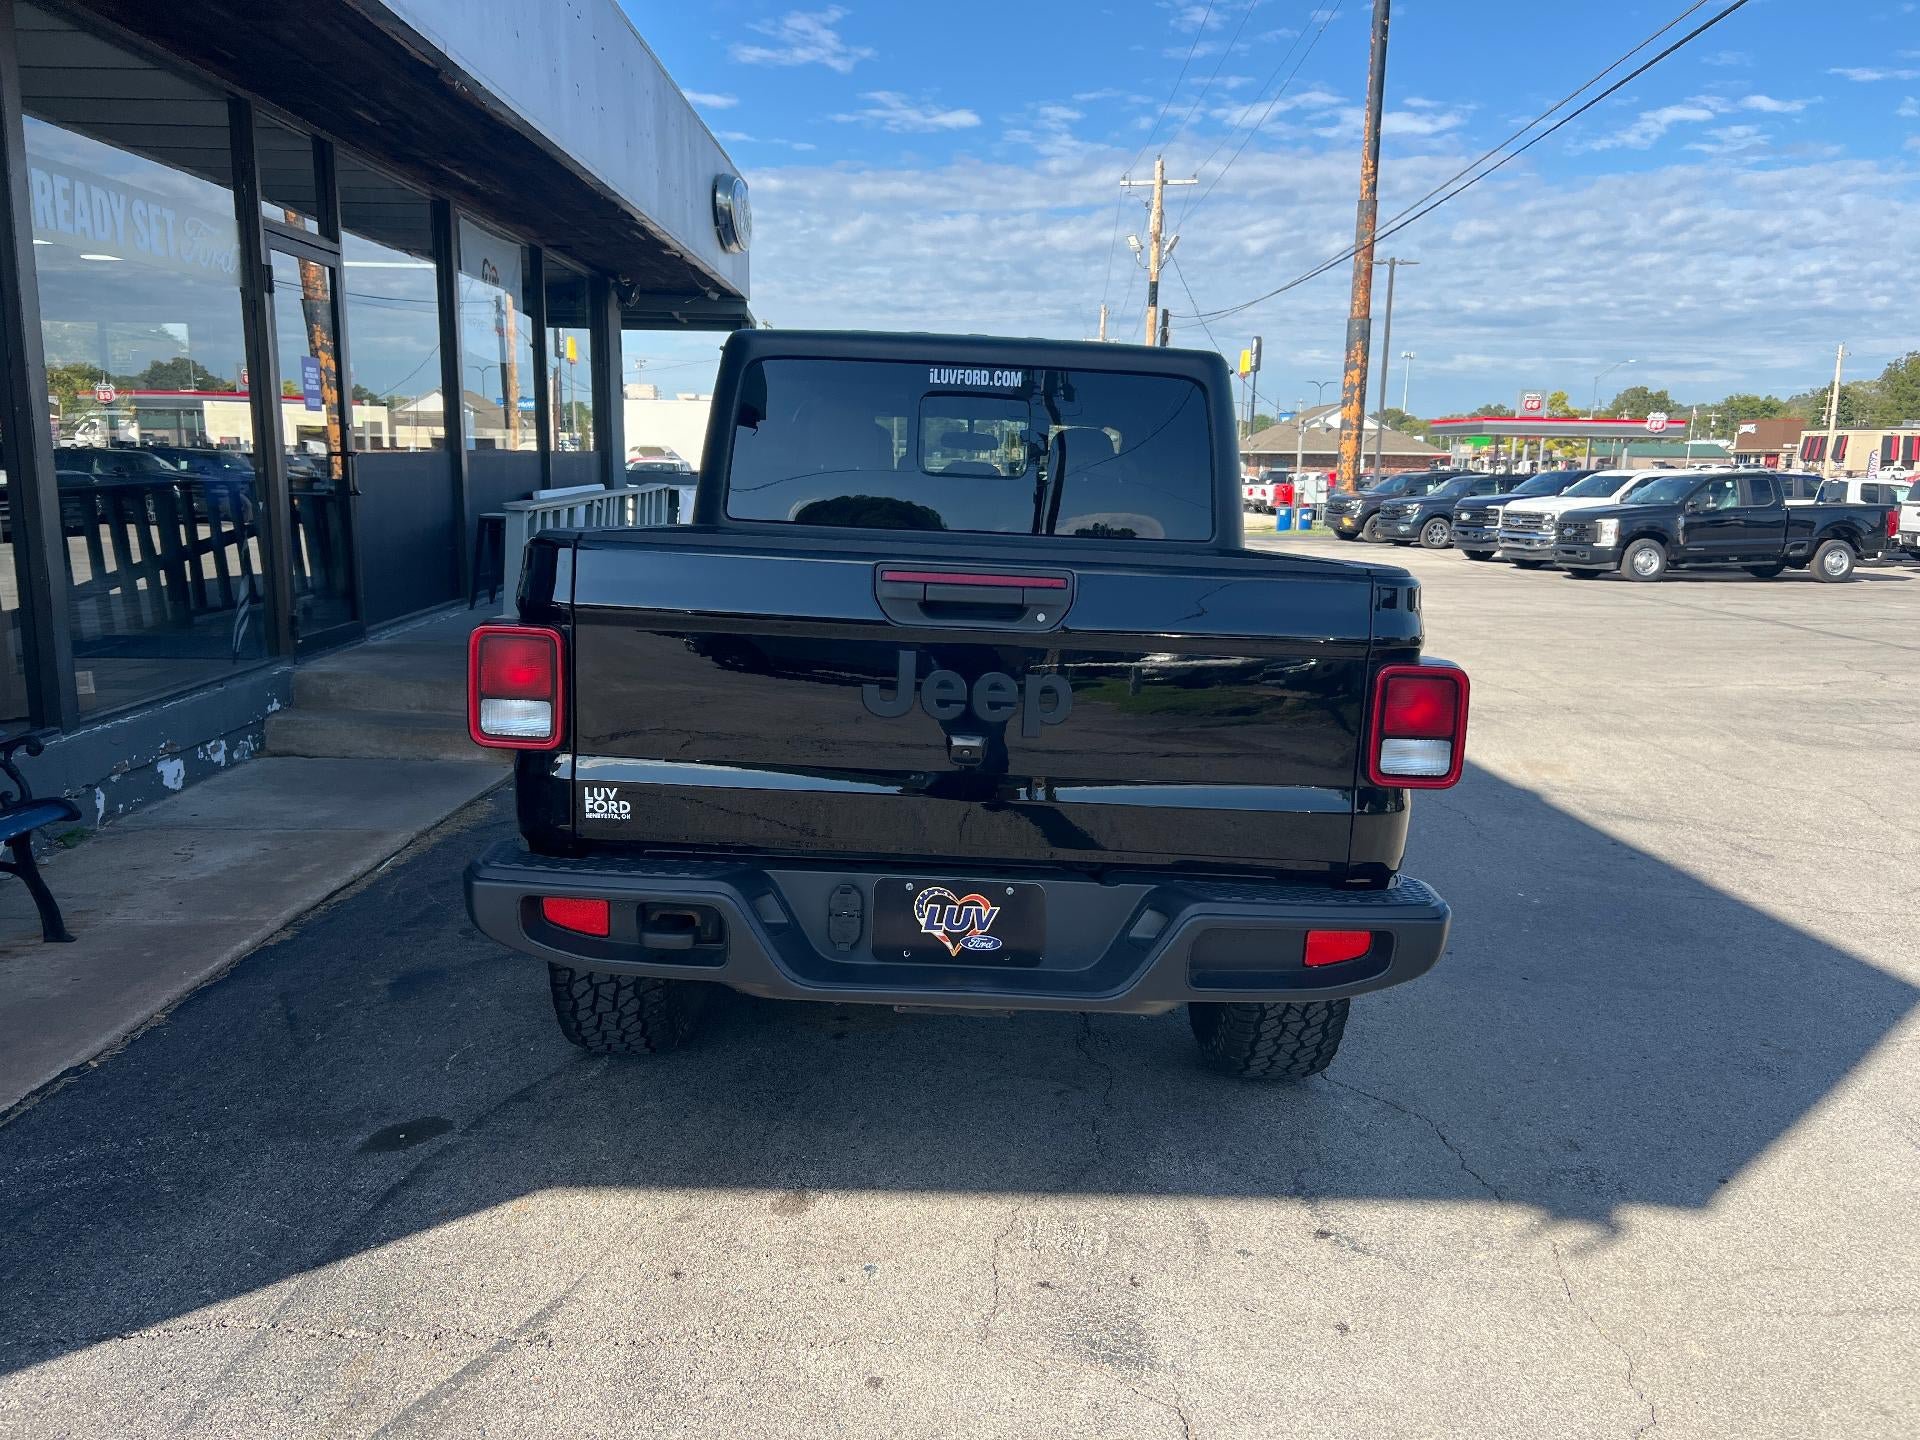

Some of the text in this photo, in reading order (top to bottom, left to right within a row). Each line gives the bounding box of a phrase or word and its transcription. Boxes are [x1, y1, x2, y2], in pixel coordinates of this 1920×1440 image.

[31, 168, 238, 273] READY SET Ford
[929, 368, 1022, 387] iLUVFORD.COM
[861, 649, 1073, 737] Jeep
[584, 786, 618, 800] LUV
[584, 800, 631, 813] FORD
[921, 904, 1001, 933] LUV
[966, 936, 998, 950] Ford
